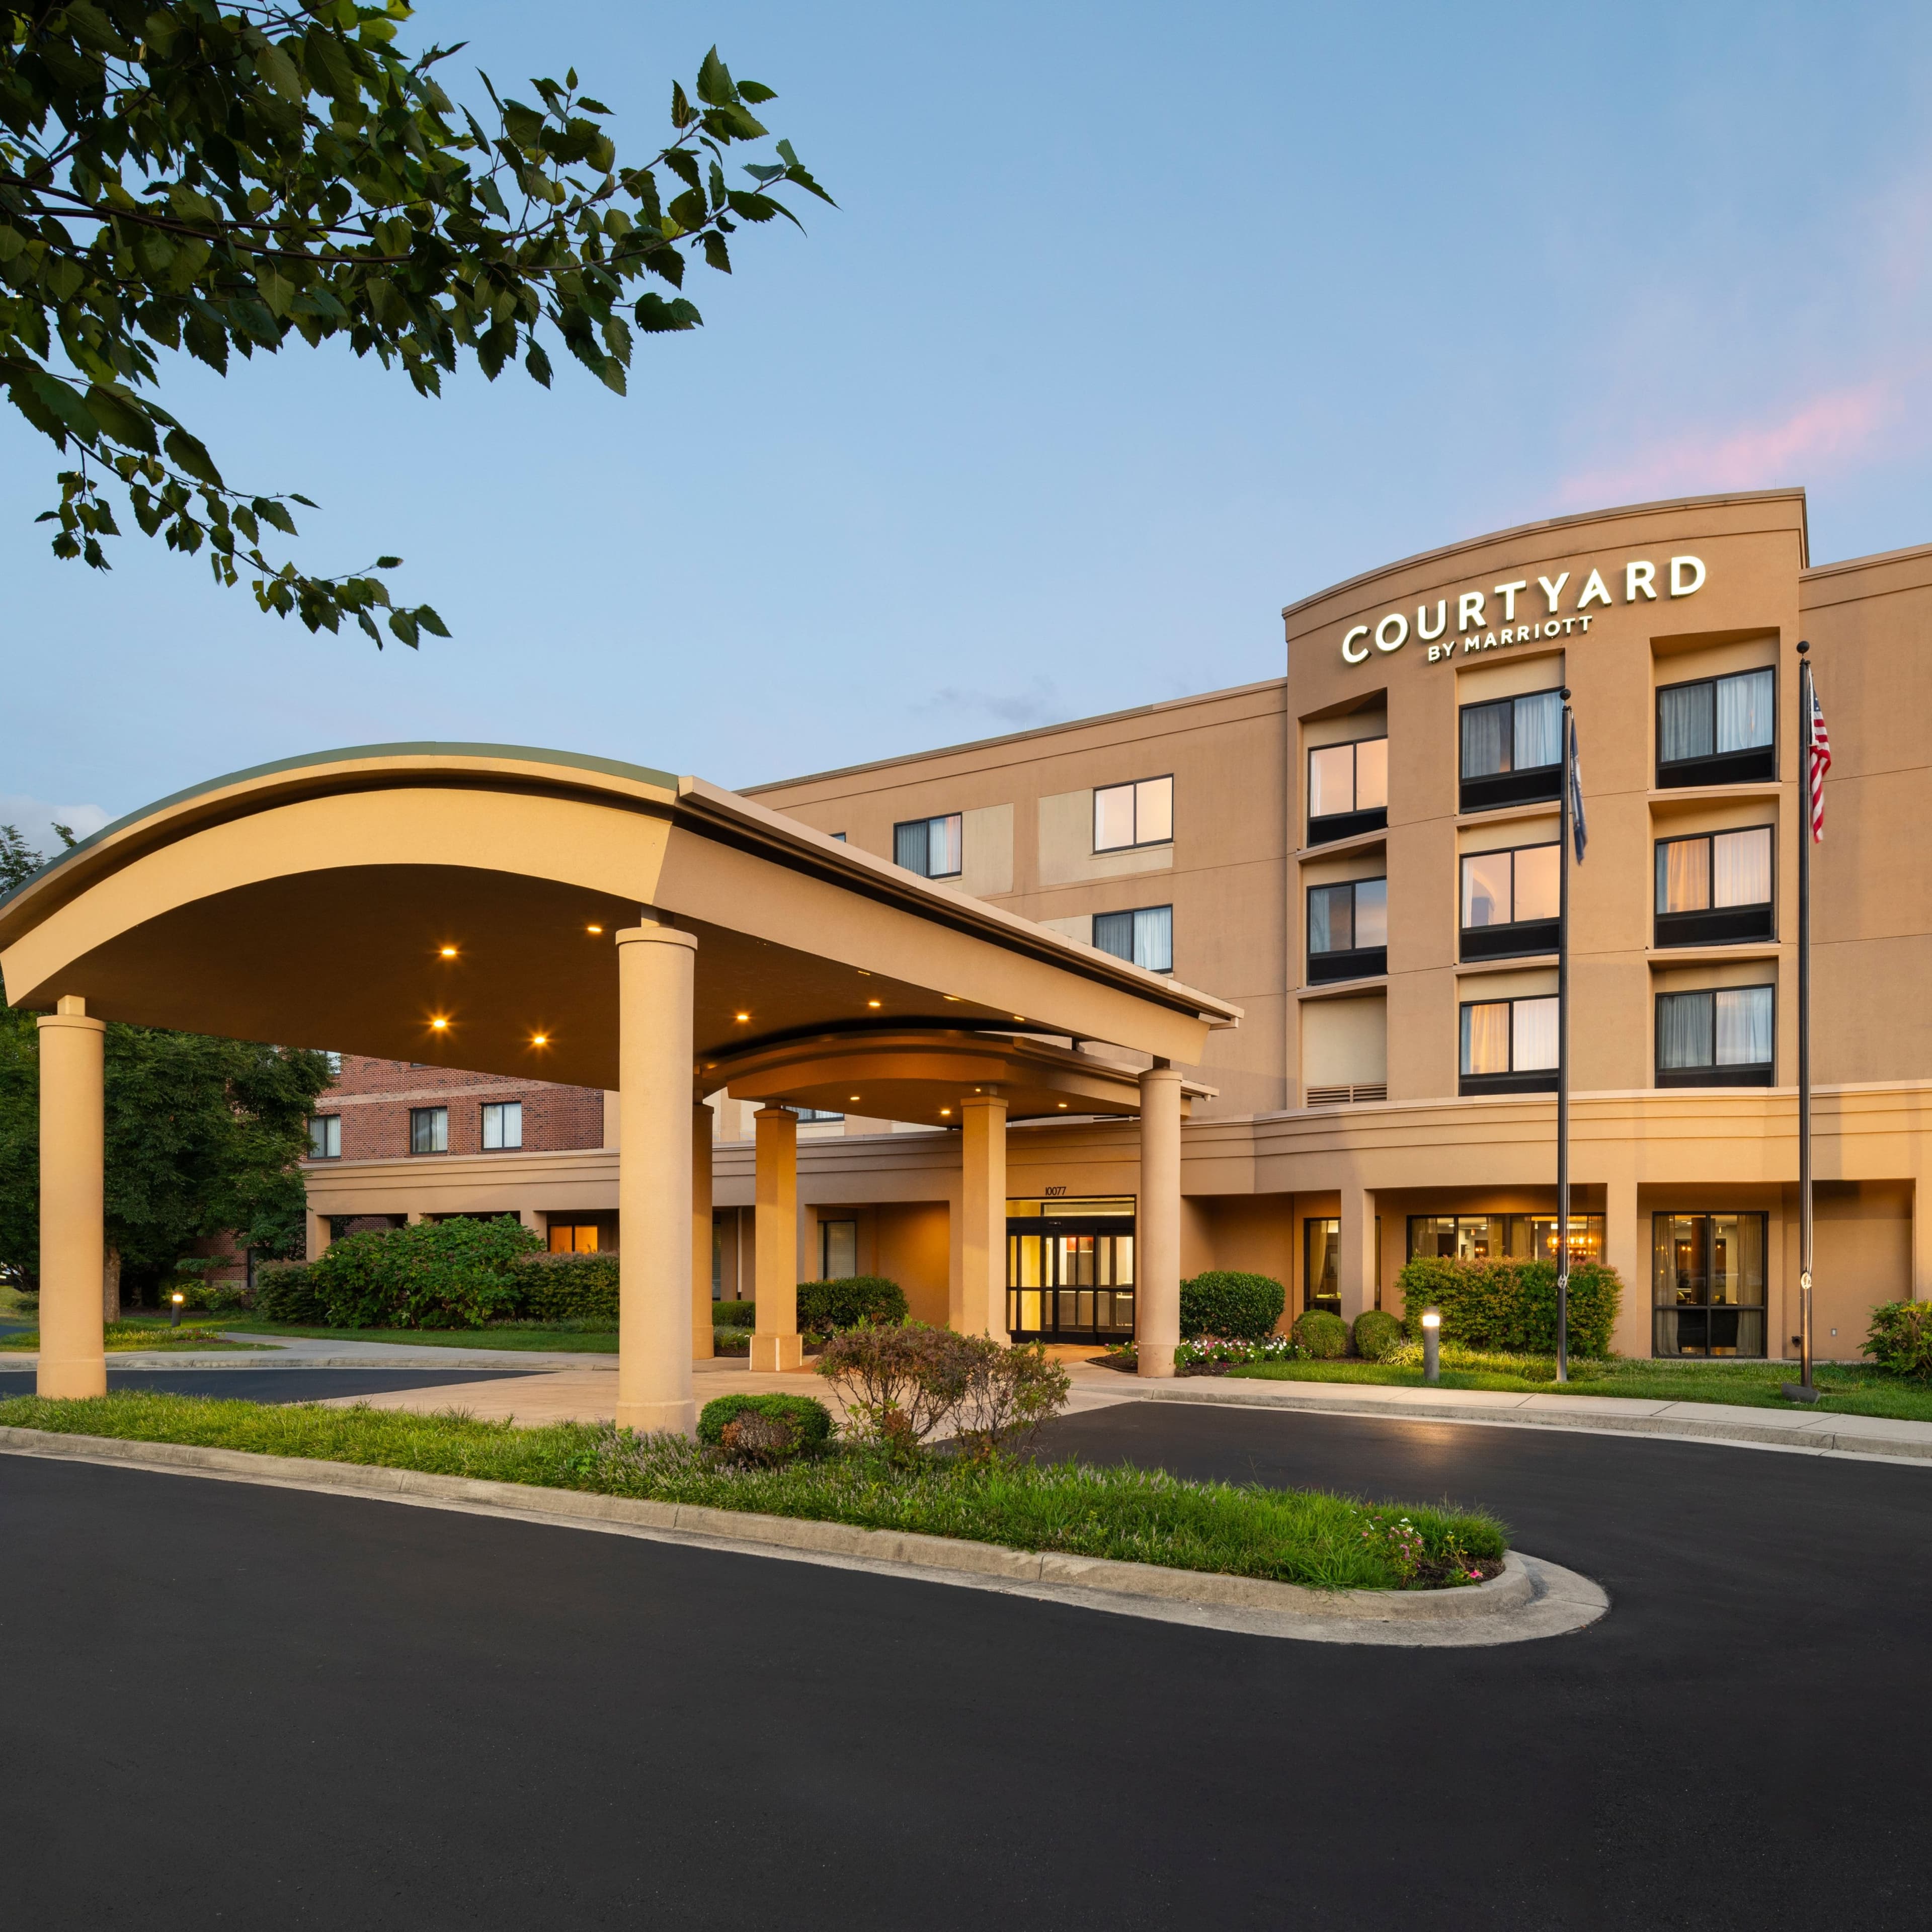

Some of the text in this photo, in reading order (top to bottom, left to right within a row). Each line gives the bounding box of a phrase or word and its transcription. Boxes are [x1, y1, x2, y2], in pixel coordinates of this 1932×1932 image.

[1340, 555, 1707, 664] COURTYARD
[1427, 615, 1593, 663] BY MARRIOTT
[1045, 1186, 1067, 1195] 10077
